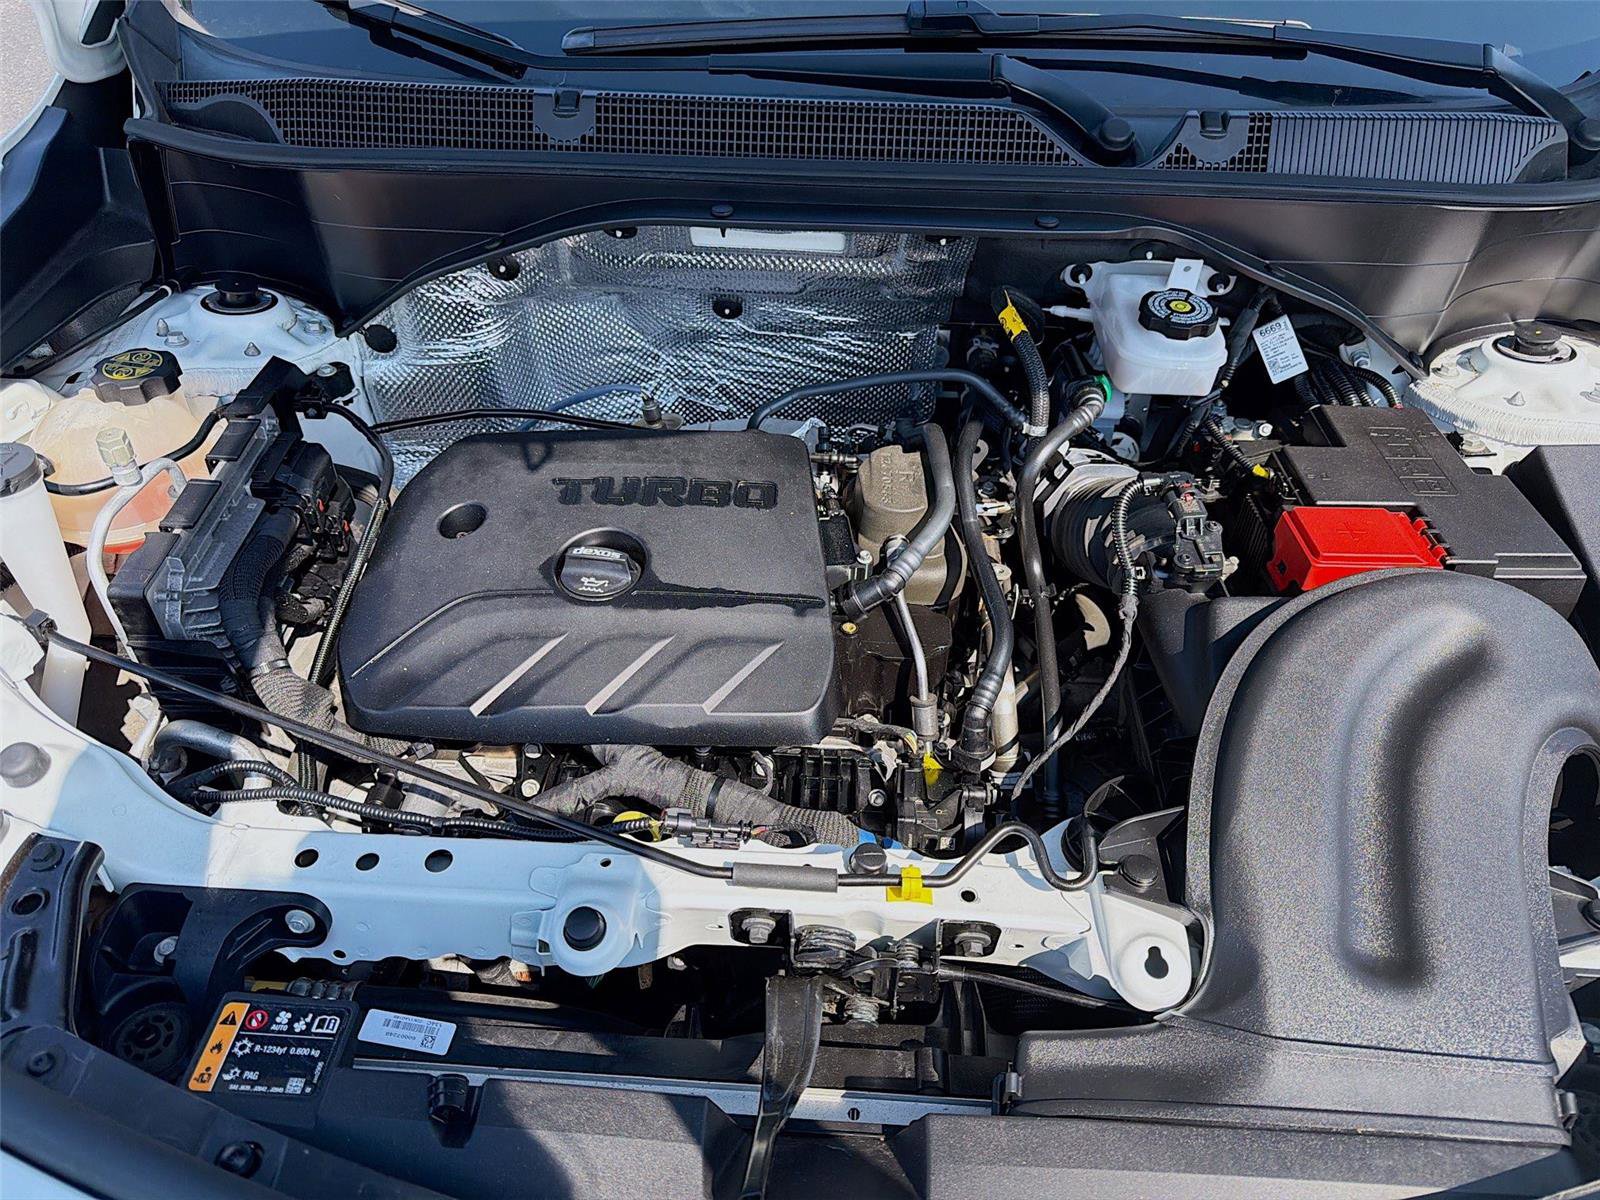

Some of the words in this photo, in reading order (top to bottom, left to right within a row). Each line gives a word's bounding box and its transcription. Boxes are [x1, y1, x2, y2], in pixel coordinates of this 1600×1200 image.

[1260, 322, 1282, 337] 6669
[552, 476, 779, 510] TURBO
[572, 546, 623, 560] dexos
[271, 1024, 288, 1032] AUTO
[254, 1044, 288, 1056] R-1234yf
[310, 1048, 321, 1058] kg
[243, 1070, 260, 1080] PAG
